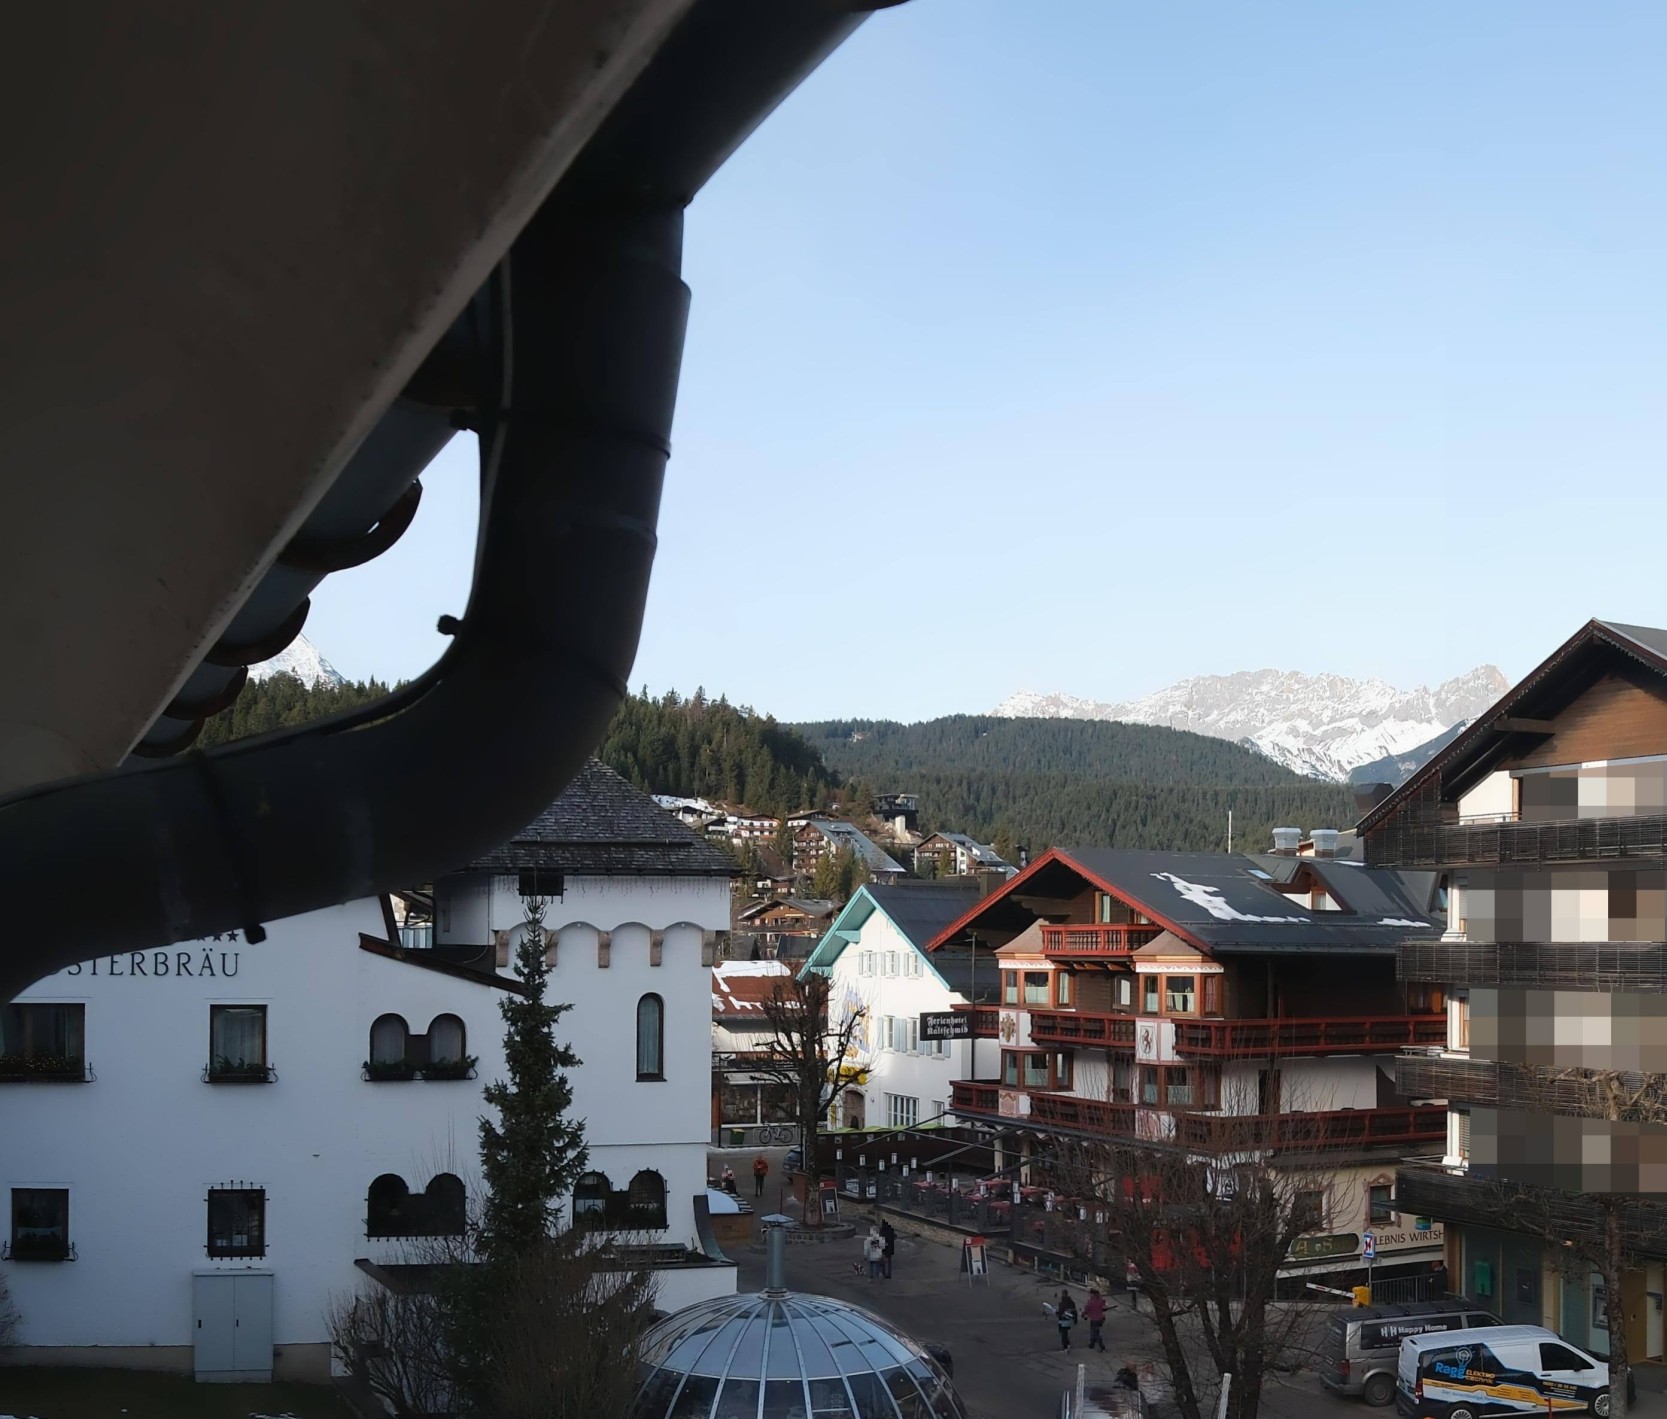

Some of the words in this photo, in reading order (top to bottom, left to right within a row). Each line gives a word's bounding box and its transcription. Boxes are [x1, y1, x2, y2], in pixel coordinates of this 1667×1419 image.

[1376, 1232, 1405, 1246] LEBNIS
[1409, 1230, 1444, 1242] WIRTSH
[1398, 1326, 1423, 1335] Happy
[1424, 1324, 1448, 1332] Home
[1435, 1362, 1465, 1379] Ragg
